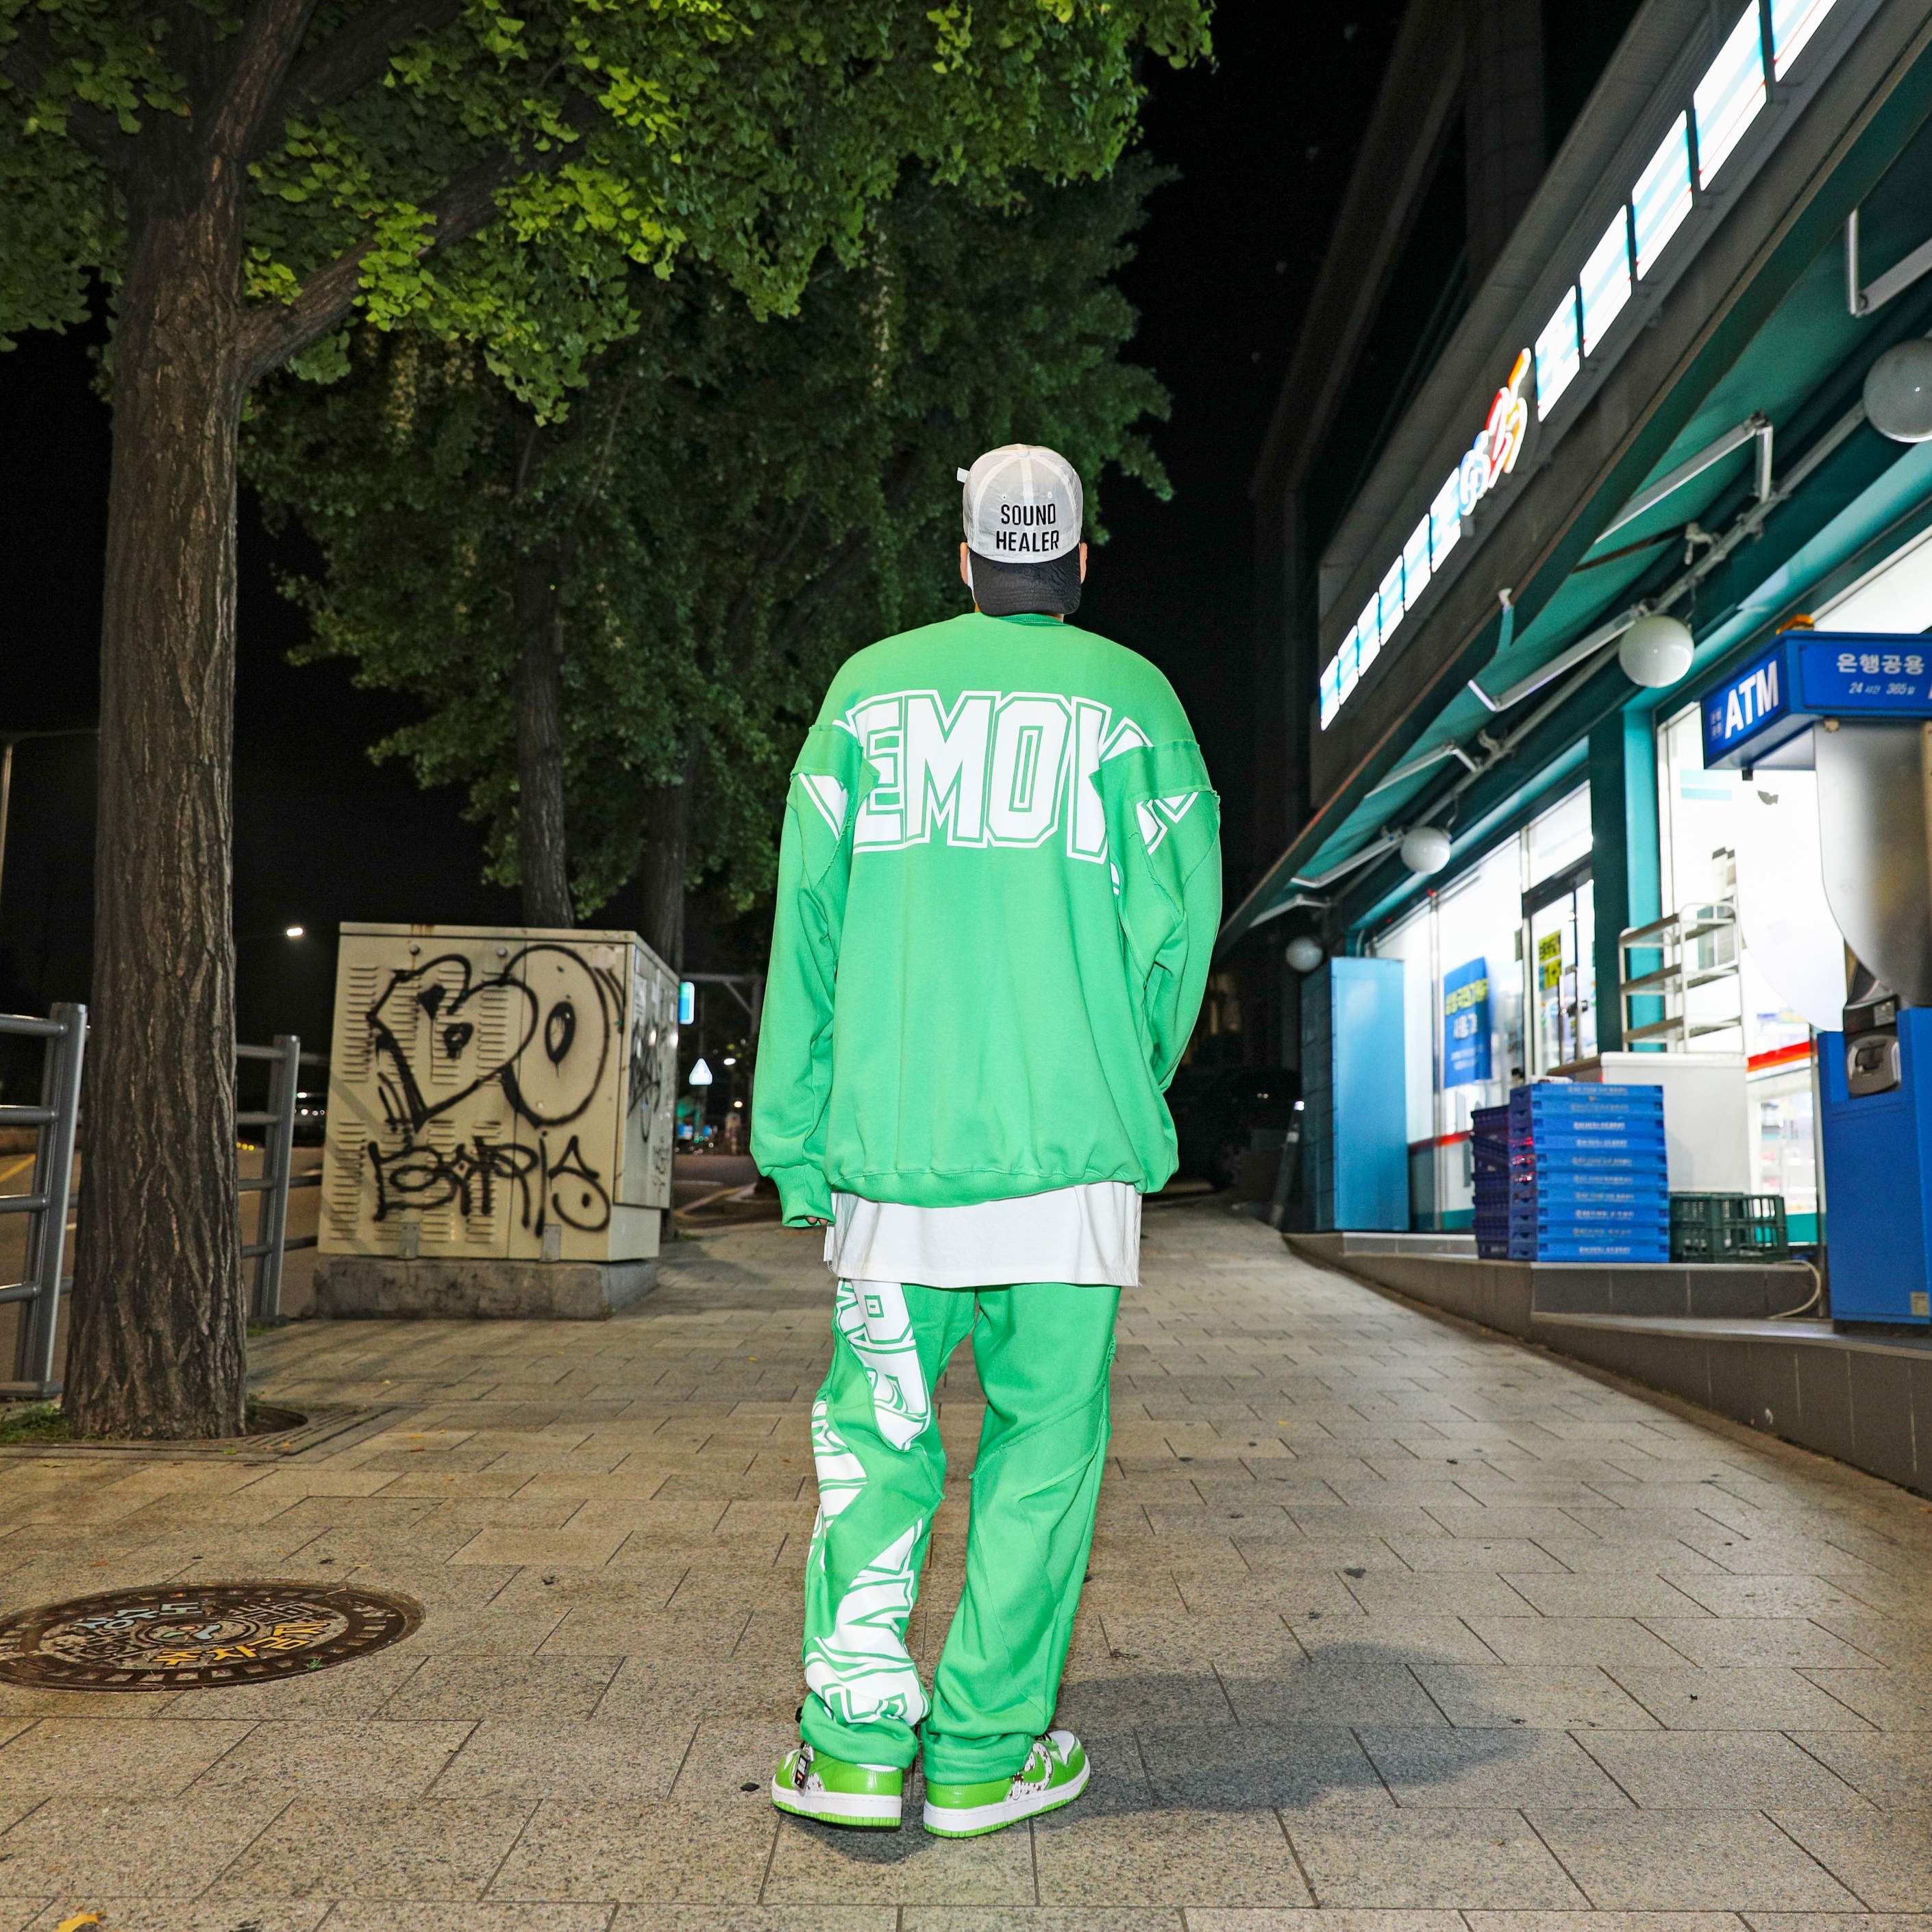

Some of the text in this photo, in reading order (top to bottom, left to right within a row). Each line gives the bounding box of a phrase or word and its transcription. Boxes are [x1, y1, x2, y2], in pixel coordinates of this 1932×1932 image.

[1001, 504, 1056, 525] SOUND
[995, 530, 1059, 552] HEALER
[1836, 653, 1925, 676] 은행공용
[1724, 660, 1779, 740] ATM
[73, 1602, 203, 1630] 상수도
[149, 1622, 330, 1666] 주차금지
